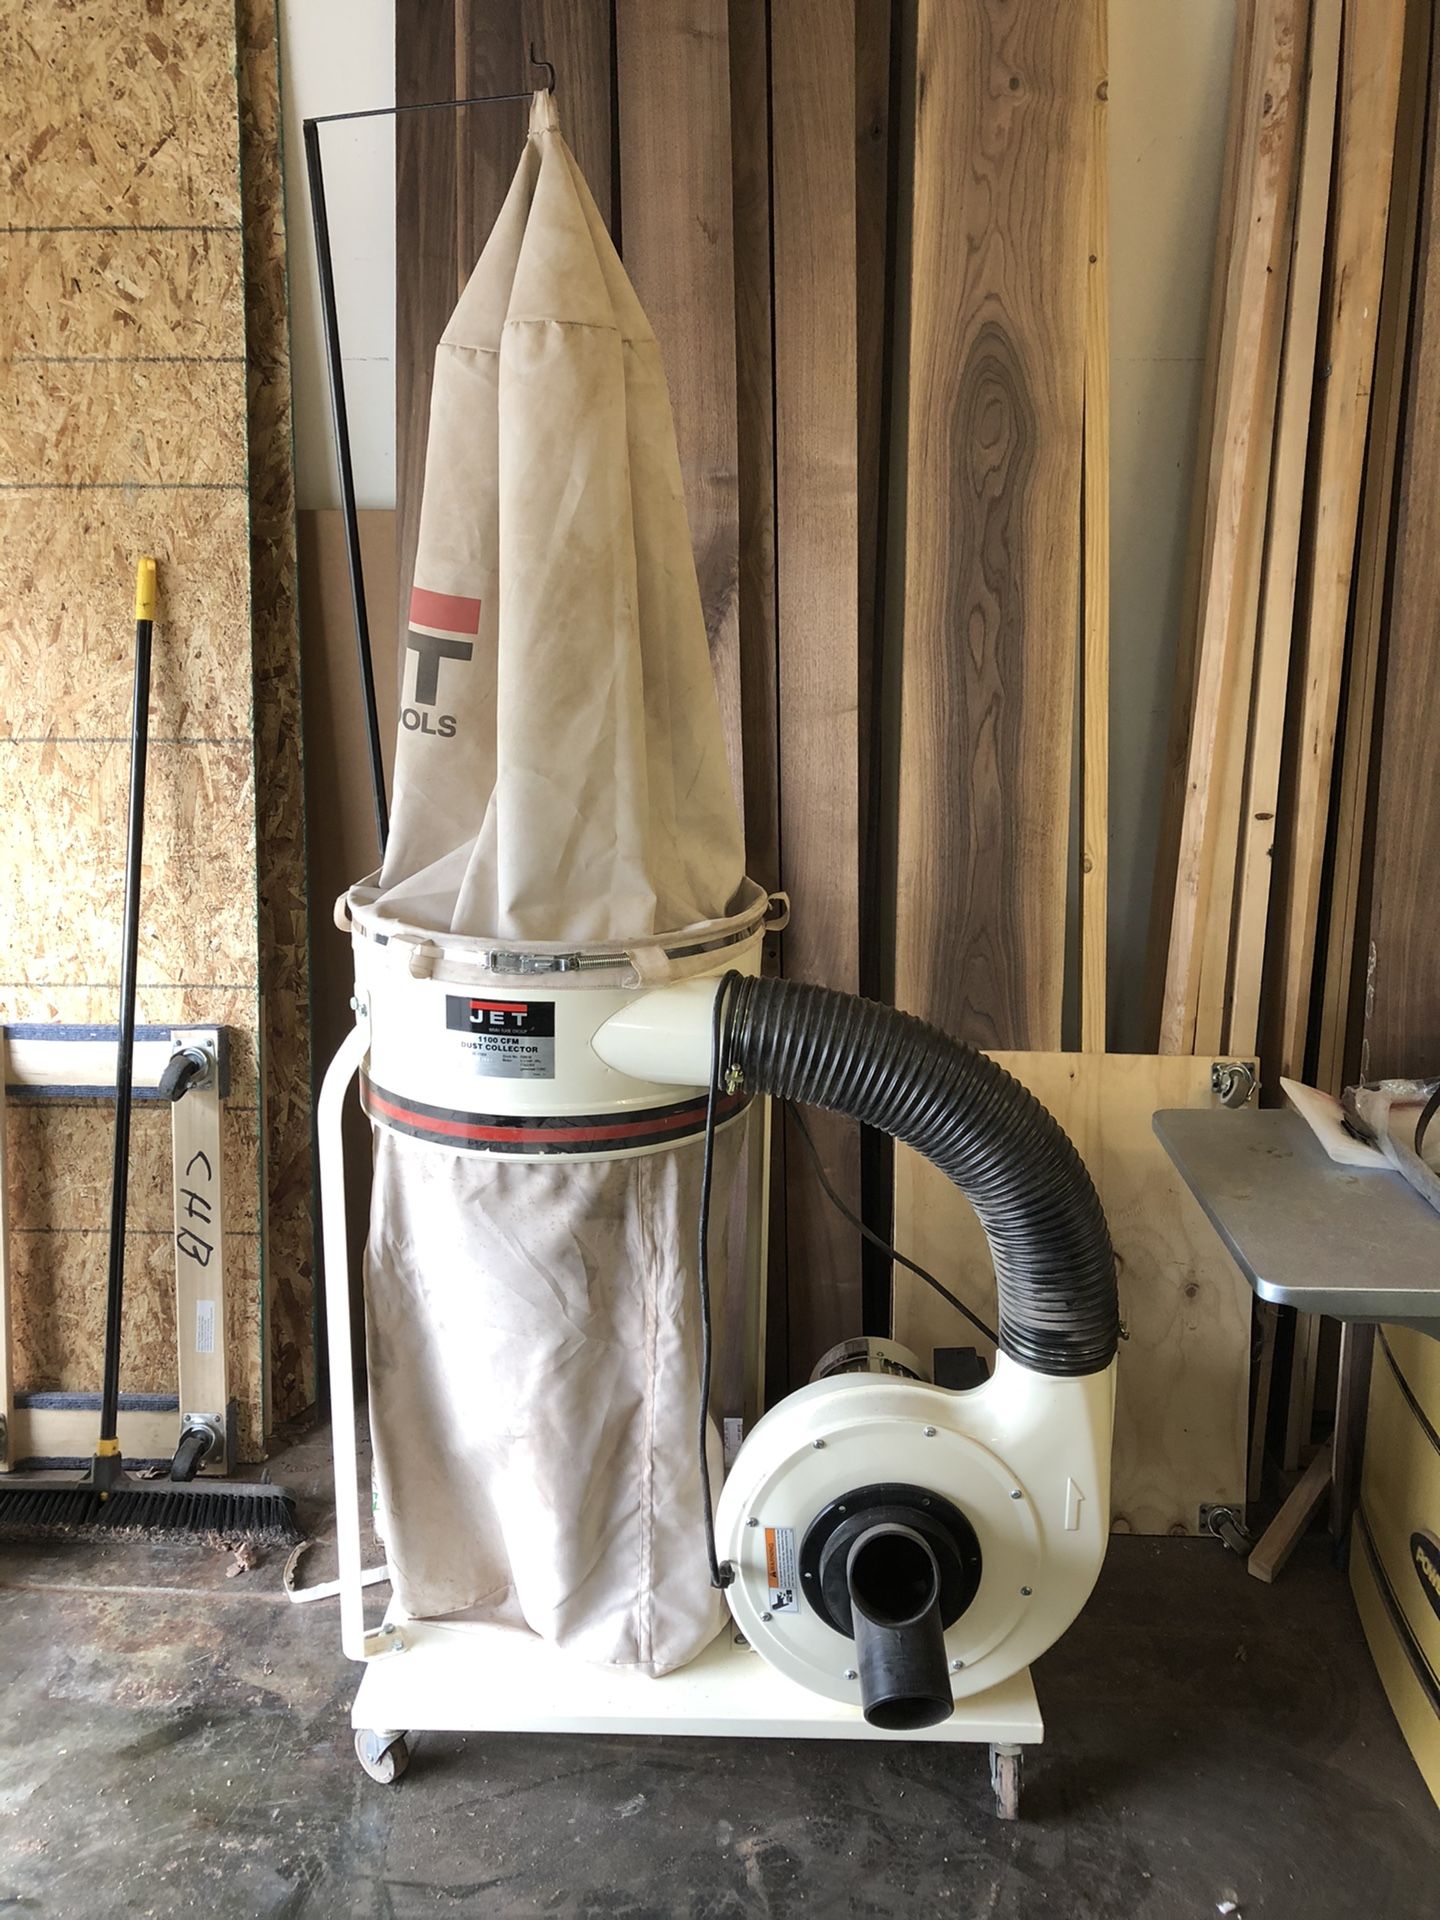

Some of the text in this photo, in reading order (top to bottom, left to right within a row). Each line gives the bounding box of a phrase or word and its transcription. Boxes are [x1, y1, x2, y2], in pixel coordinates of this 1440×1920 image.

[402, 708, 457, 738] OLS
[469, 1010, 528, 1026] JET
[461, 1041, 538, 1053] DUST COLLECTOR
[478, 1036, 519, 1045] 1100 CFM
[768, 1542, 776, 1571] WARNING
